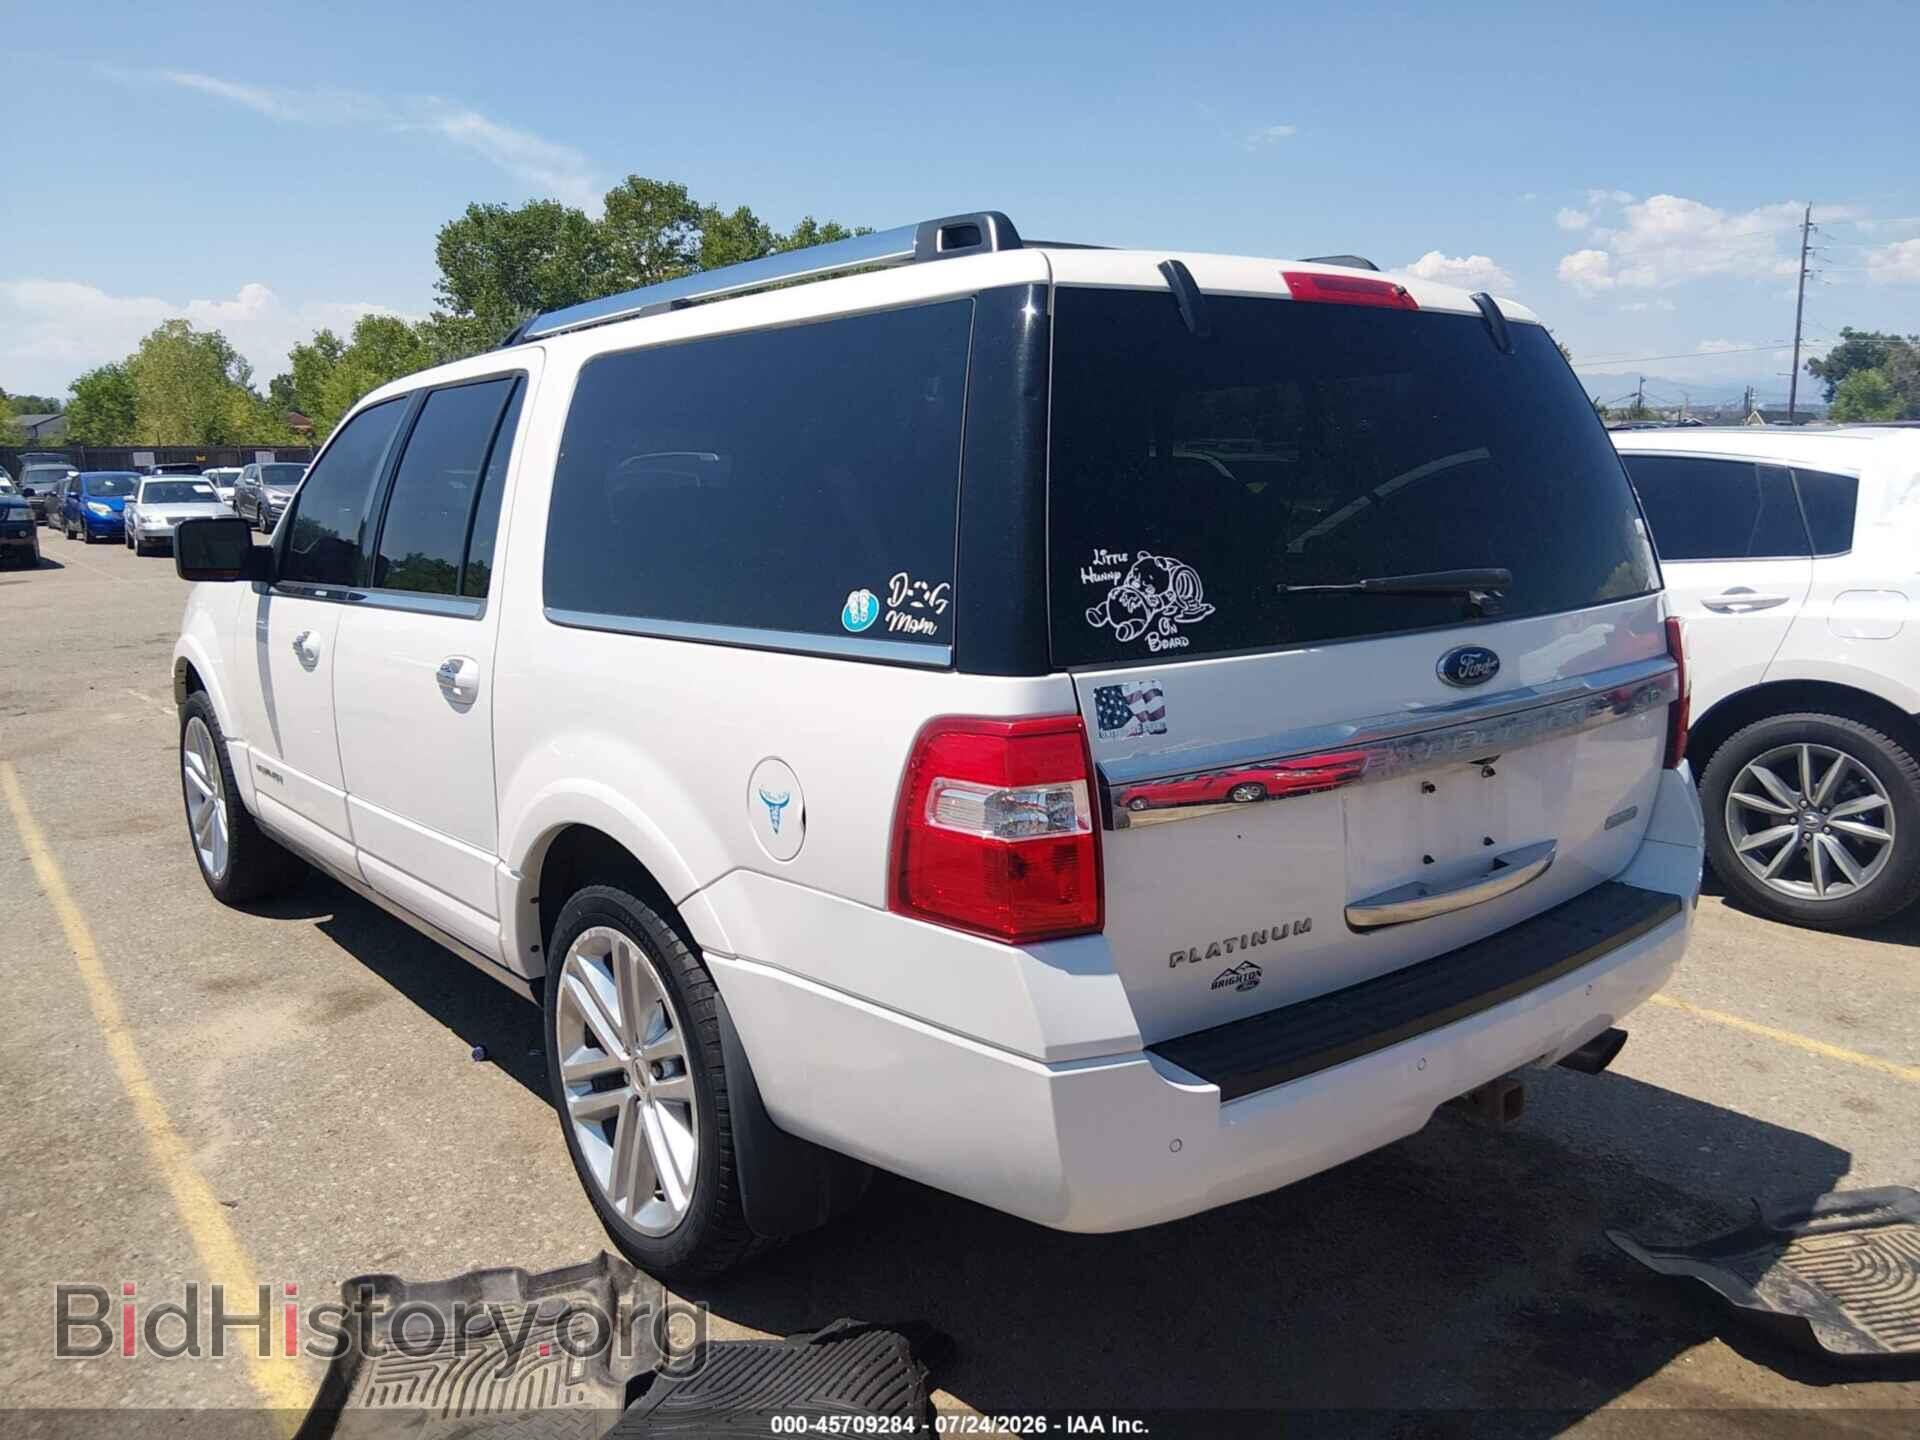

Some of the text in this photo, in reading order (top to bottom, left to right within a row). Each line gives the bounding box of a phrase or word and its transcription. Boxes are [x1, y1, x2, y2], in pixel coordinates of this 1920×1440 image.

[1144, 631, 1190, 652] BOARD
[1458, 648, 1498, 678] Ford
[1168, 916, 1313, 969] PLATINUM
[1210, 969, 1262, 990] BRIGHTON
